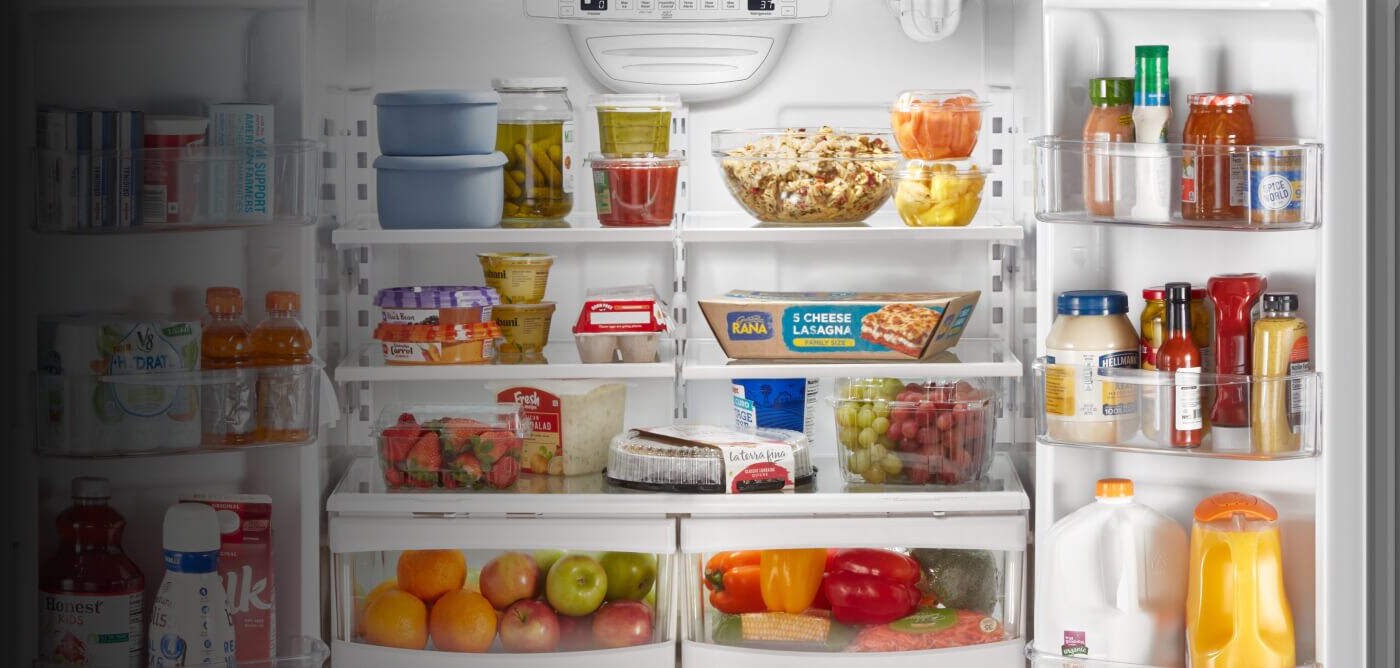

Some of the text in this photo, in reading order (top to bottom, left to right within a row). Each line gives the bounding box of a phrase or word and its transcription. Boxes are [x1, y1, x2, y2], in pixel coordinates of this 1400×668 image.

[245, 168, 254, 213] FARMERS
[254, 162, 266, 214] SUPPORT
[1264, 190, 1288, 202] ORLD
[793, 313, 852, 323] 5 CHEESE
[732, 321, 767, 334] RANA
[793, 325, 852, 335] LASAGNA
[137, 327, 153, 351] V8
[513, 391, 540, 407] Fresh
[46, 597, 101, 614] Honest
